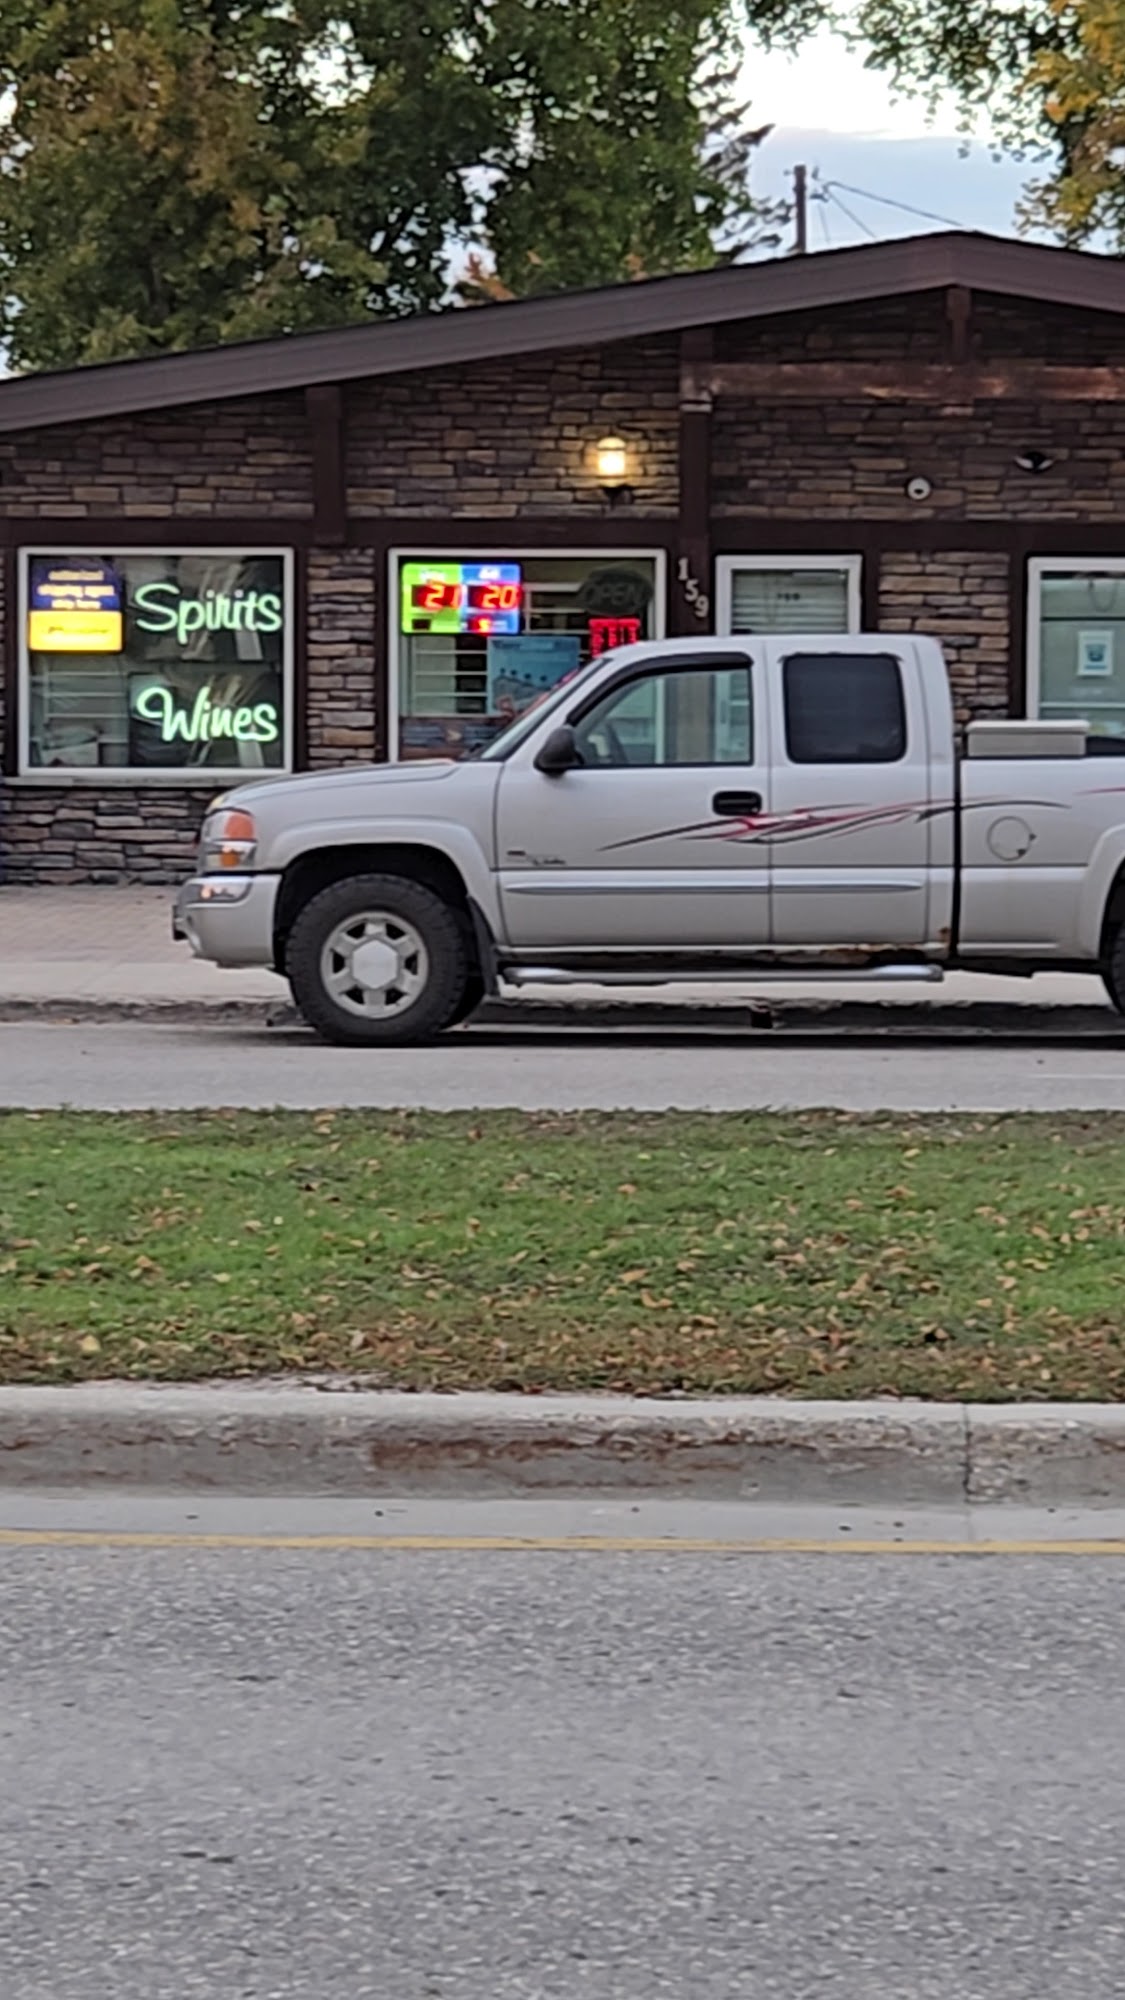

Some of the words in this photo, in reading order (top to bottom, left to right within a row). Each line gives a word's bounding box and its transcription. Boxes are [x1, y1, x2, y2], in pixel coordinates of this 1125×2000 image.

[135, 583, 282, 644] Spirits
[482, 584, 517, 610] 20
[678, 558, 709, 618] 159
[137, 687, 278, 741] Wines
